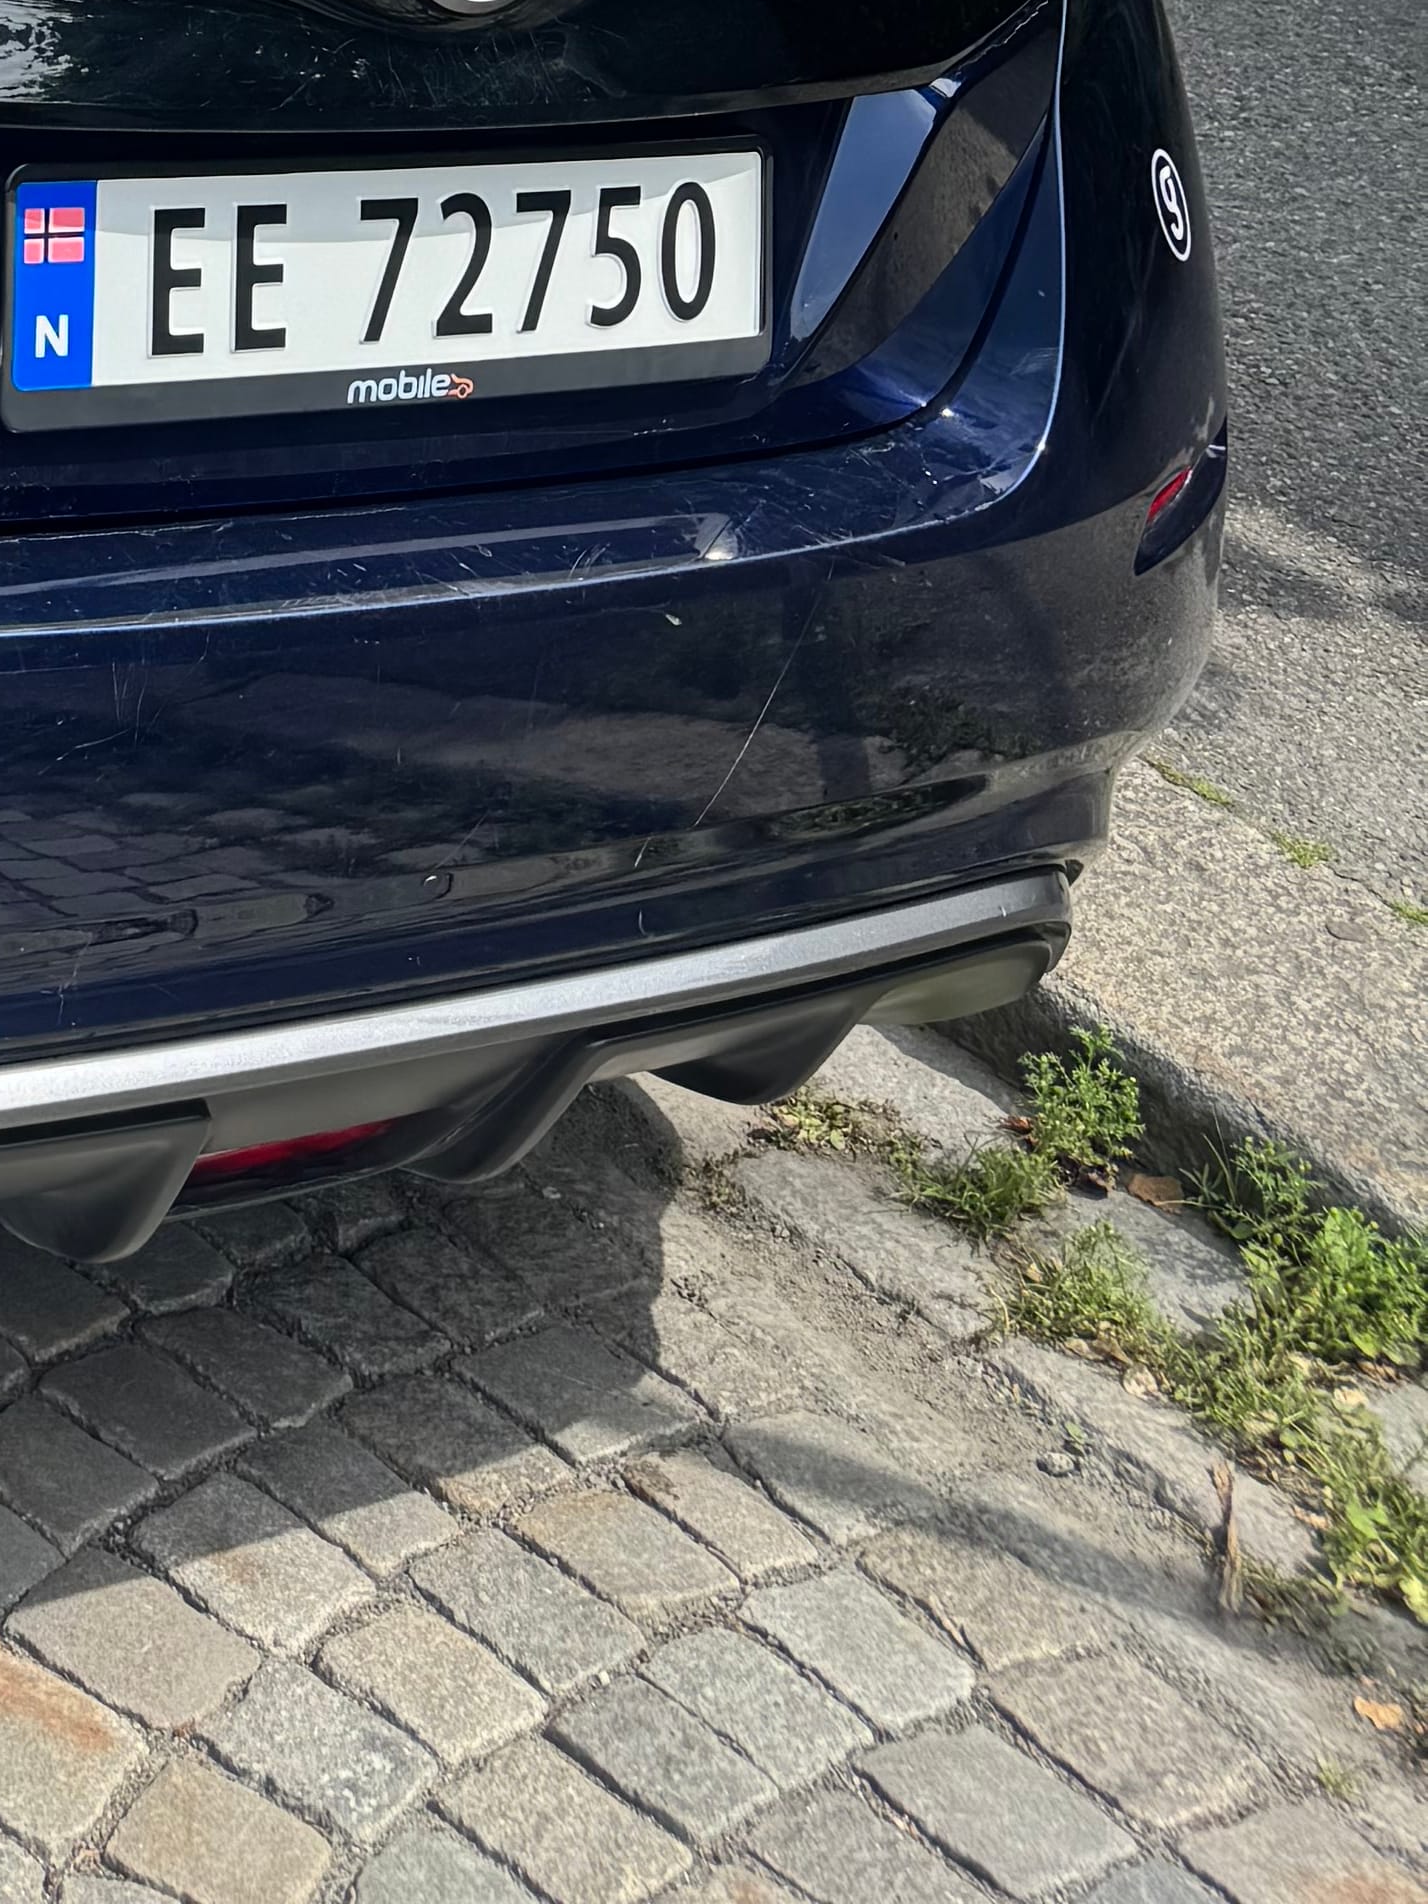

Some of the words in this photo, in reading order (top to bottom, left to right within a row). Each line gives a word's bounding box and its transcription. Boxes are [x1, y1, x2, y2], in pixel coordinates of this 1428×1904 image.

[151, 202, 289, 357] EE
[359, 180, 717, 345] 72750
[34, 313, 69, 359] N
